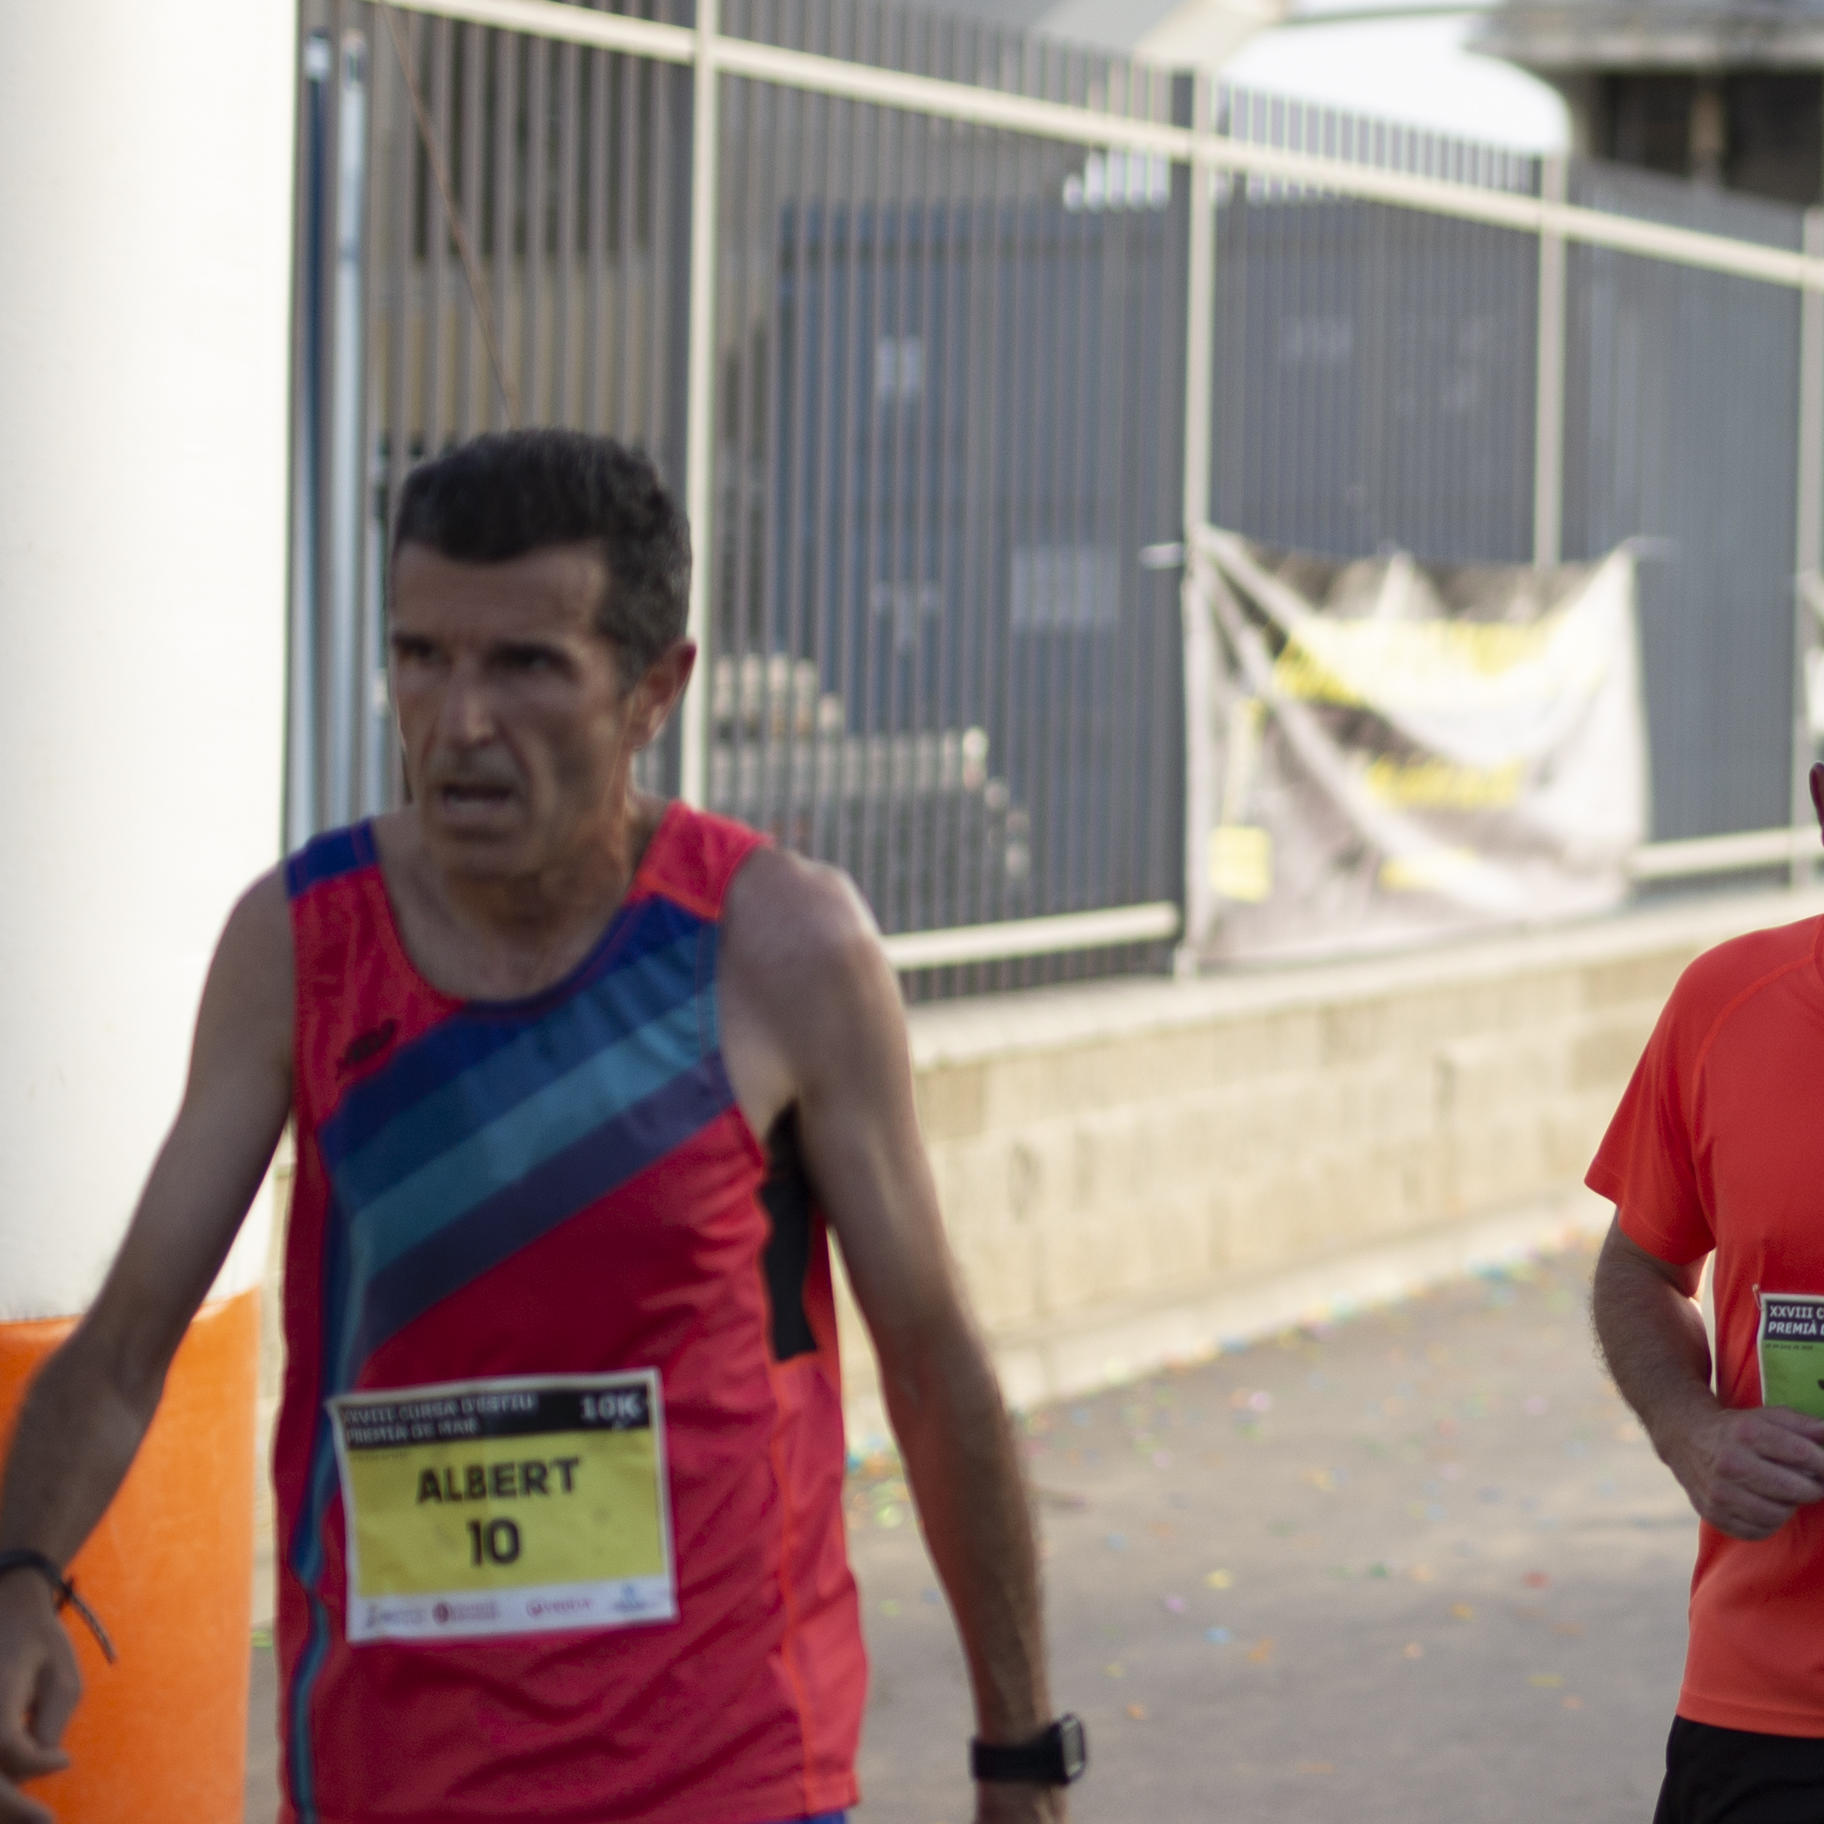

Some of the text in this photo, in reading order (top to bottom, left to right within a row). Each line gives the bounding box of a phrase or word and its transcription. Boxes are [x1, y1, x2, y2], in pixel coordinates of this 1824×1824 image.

[1767, 1319, 1817, 1335] PREMIÀ
[1769, 1305, 1813, 1319] XXVIII
[579, 1392, 645, 1423] 10K
[415, 1456, 580, 1505] ALBERT
[465, 1517, 521, 1567] 10
